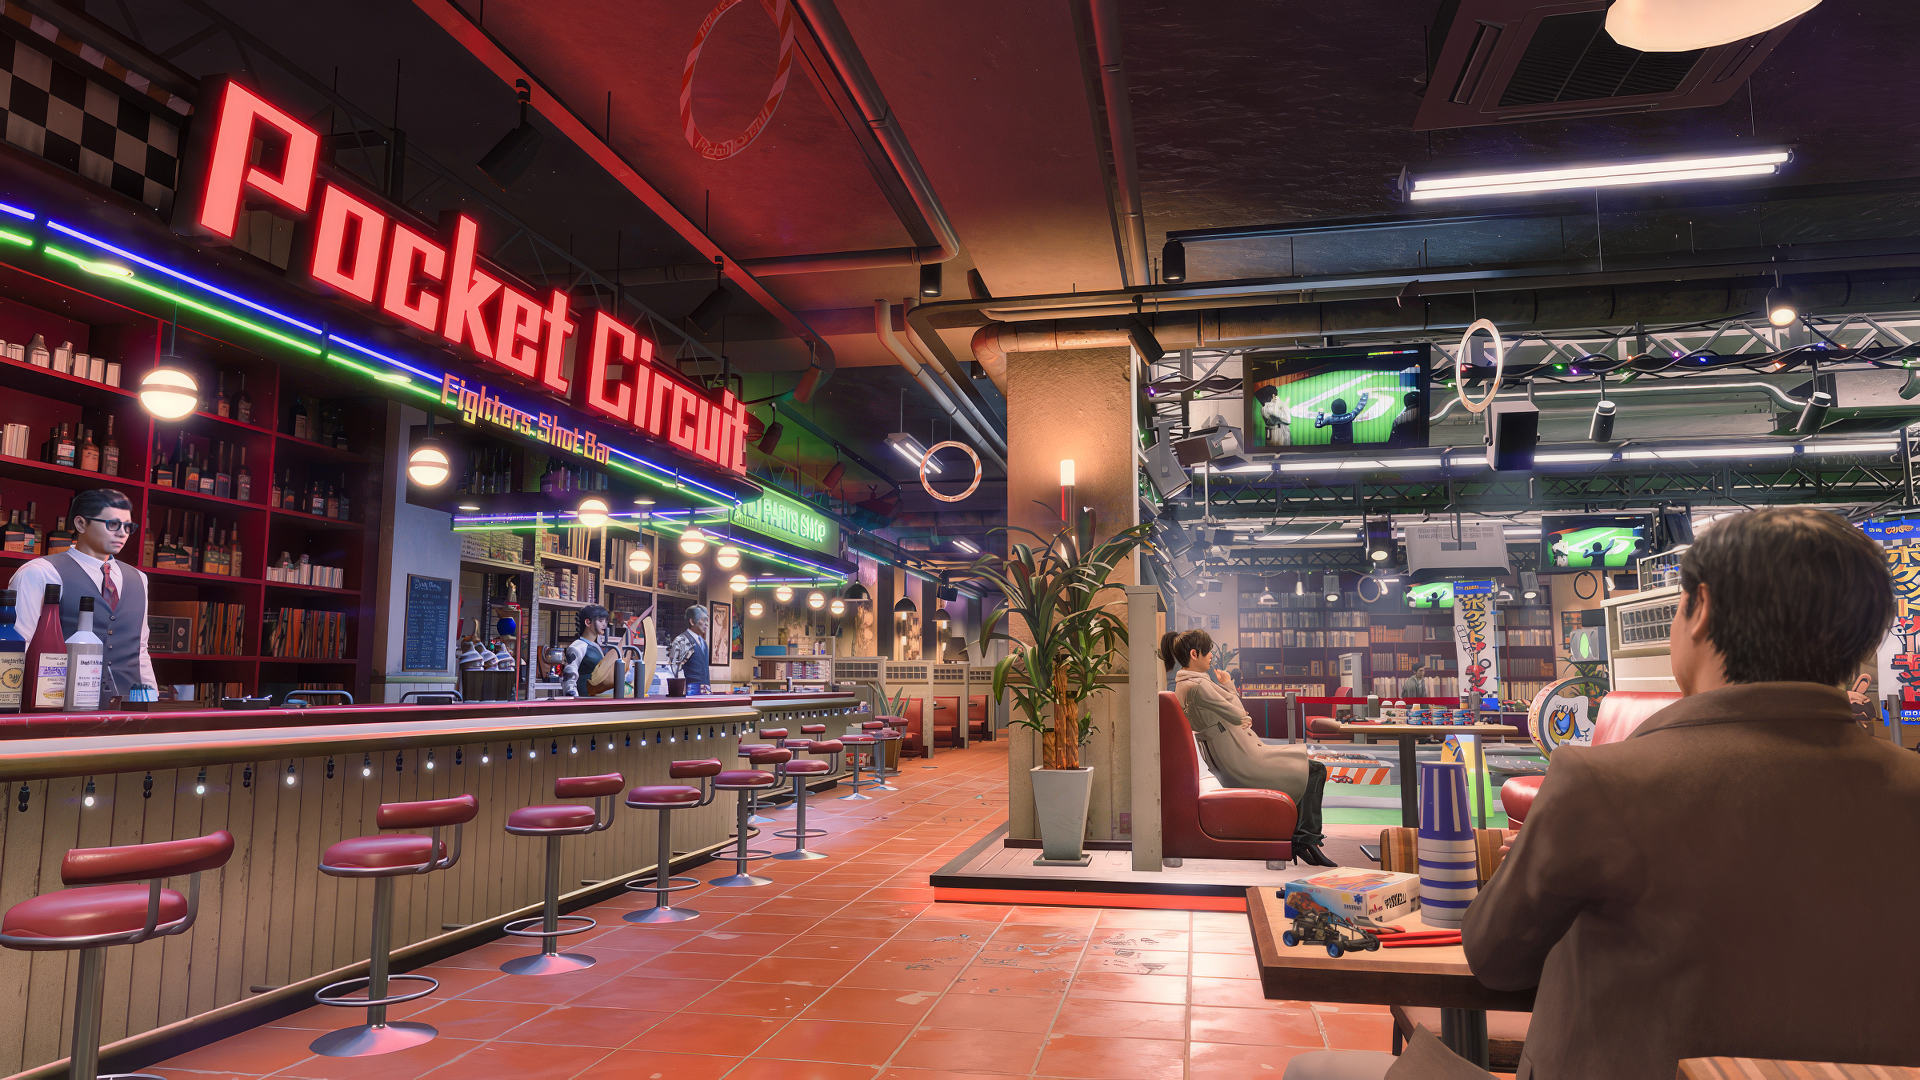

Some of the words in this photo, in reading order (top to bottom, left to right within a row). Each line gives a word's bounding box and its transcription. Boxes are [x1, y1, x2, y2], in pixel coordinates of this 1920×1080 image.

[200, 79, 575, 394] Pocket
[585, 309, 749, 476] Circuit
[441, 372, 531, 436] Fighters
[537, 411, 579, 454] Shot
[583, 430, 610, 465] Bar
